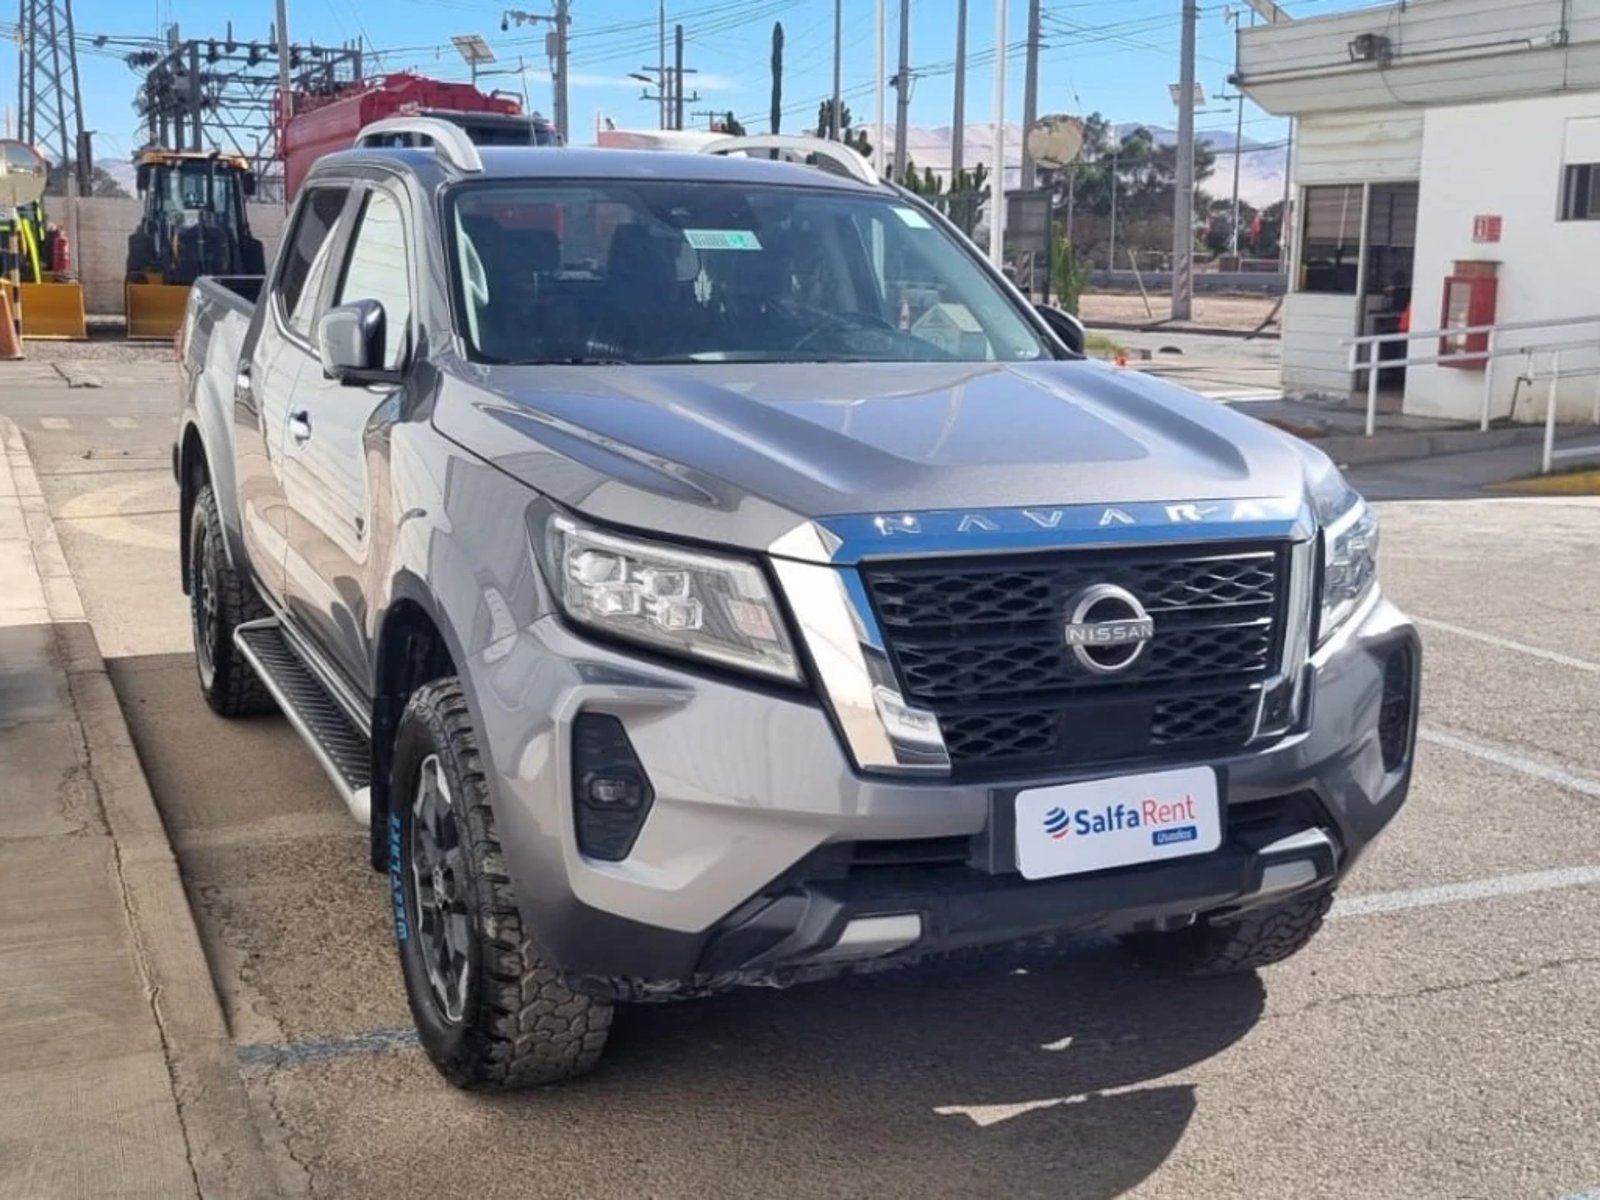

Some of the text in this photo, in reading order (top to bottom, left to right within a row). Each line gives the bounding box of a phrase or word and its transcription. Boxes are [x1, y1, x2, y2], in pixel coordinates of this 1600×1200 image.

[874, 501, 1265, 536] NAVARA
[1069, 624, 1153, 641] NISSAN
[1074, 795, 1196, 835] SalfaRent
